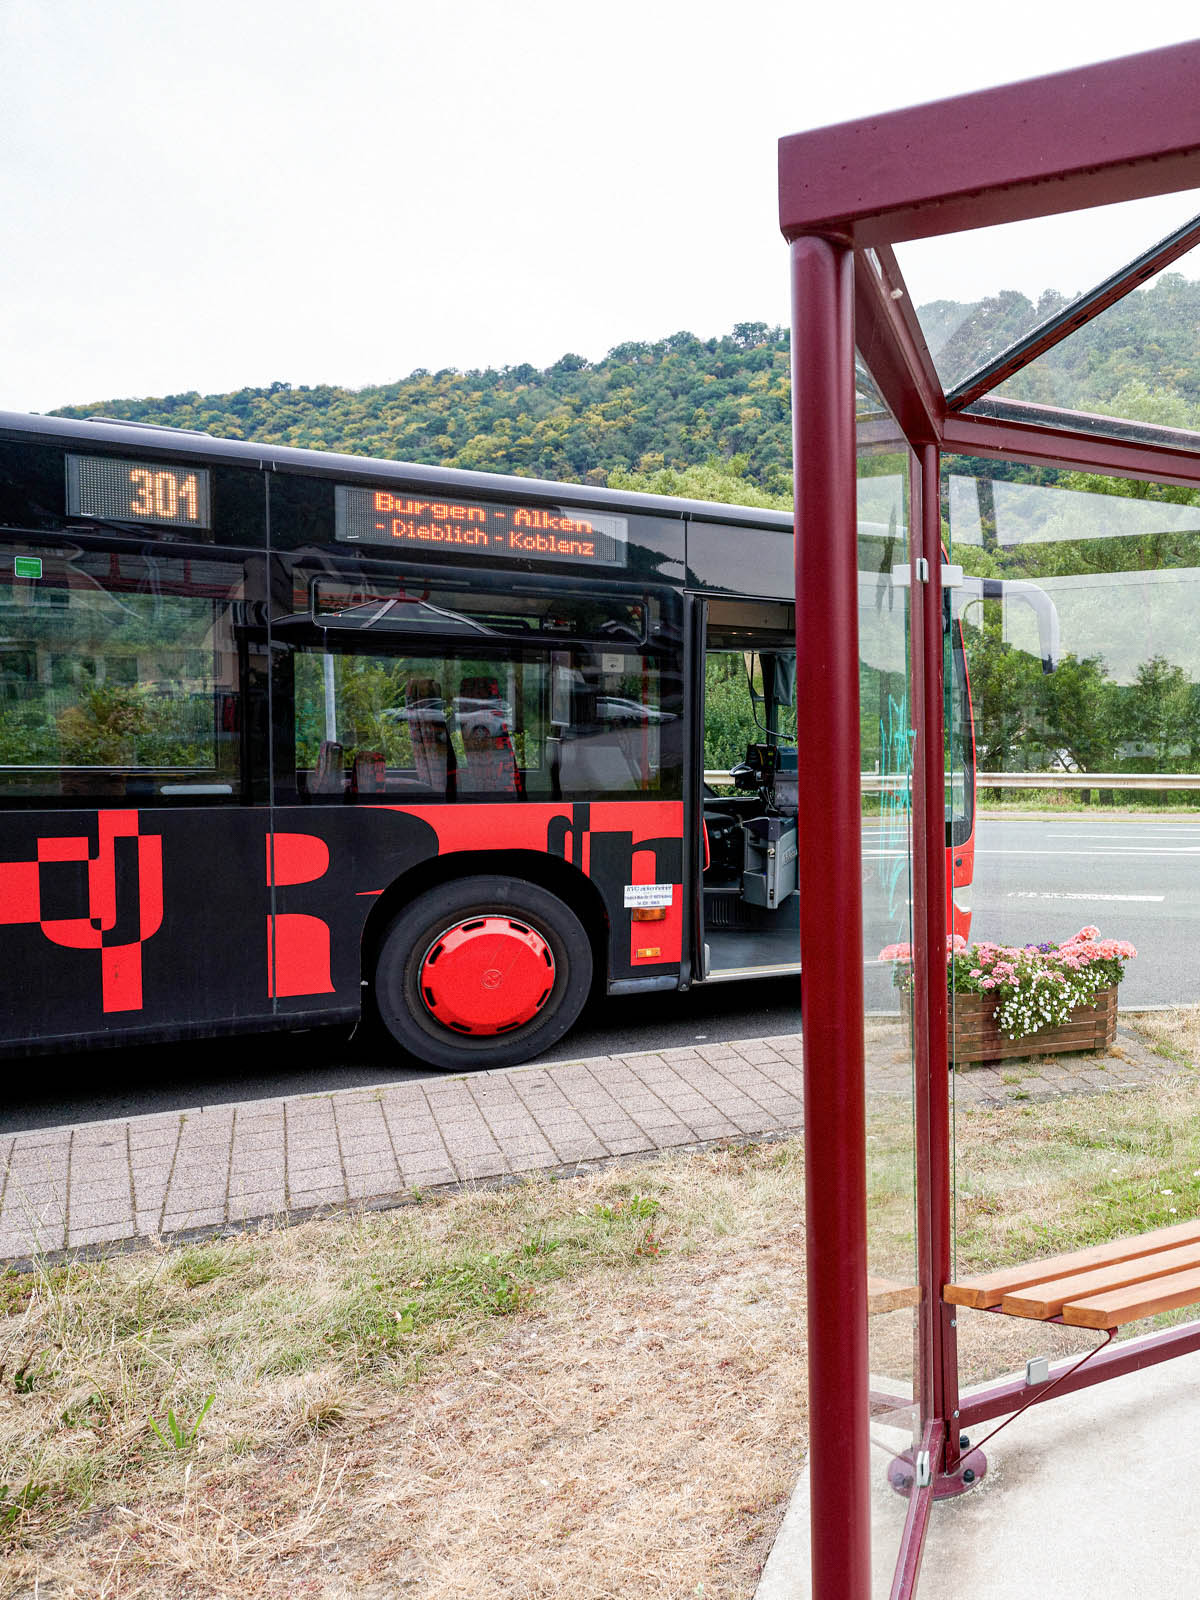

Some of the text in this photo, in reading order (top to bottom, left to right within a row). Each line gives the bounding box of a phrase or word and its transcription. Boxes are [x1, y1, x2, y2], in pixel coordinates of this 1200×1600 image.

[130, 468, 198, 520] 301
[374, 491, 486, 522] Burgen
[514, 508, 594, 534] Alken
[391, 518, 489, 546] Dieblich
[509, 530, 595, 556] Koblenz
